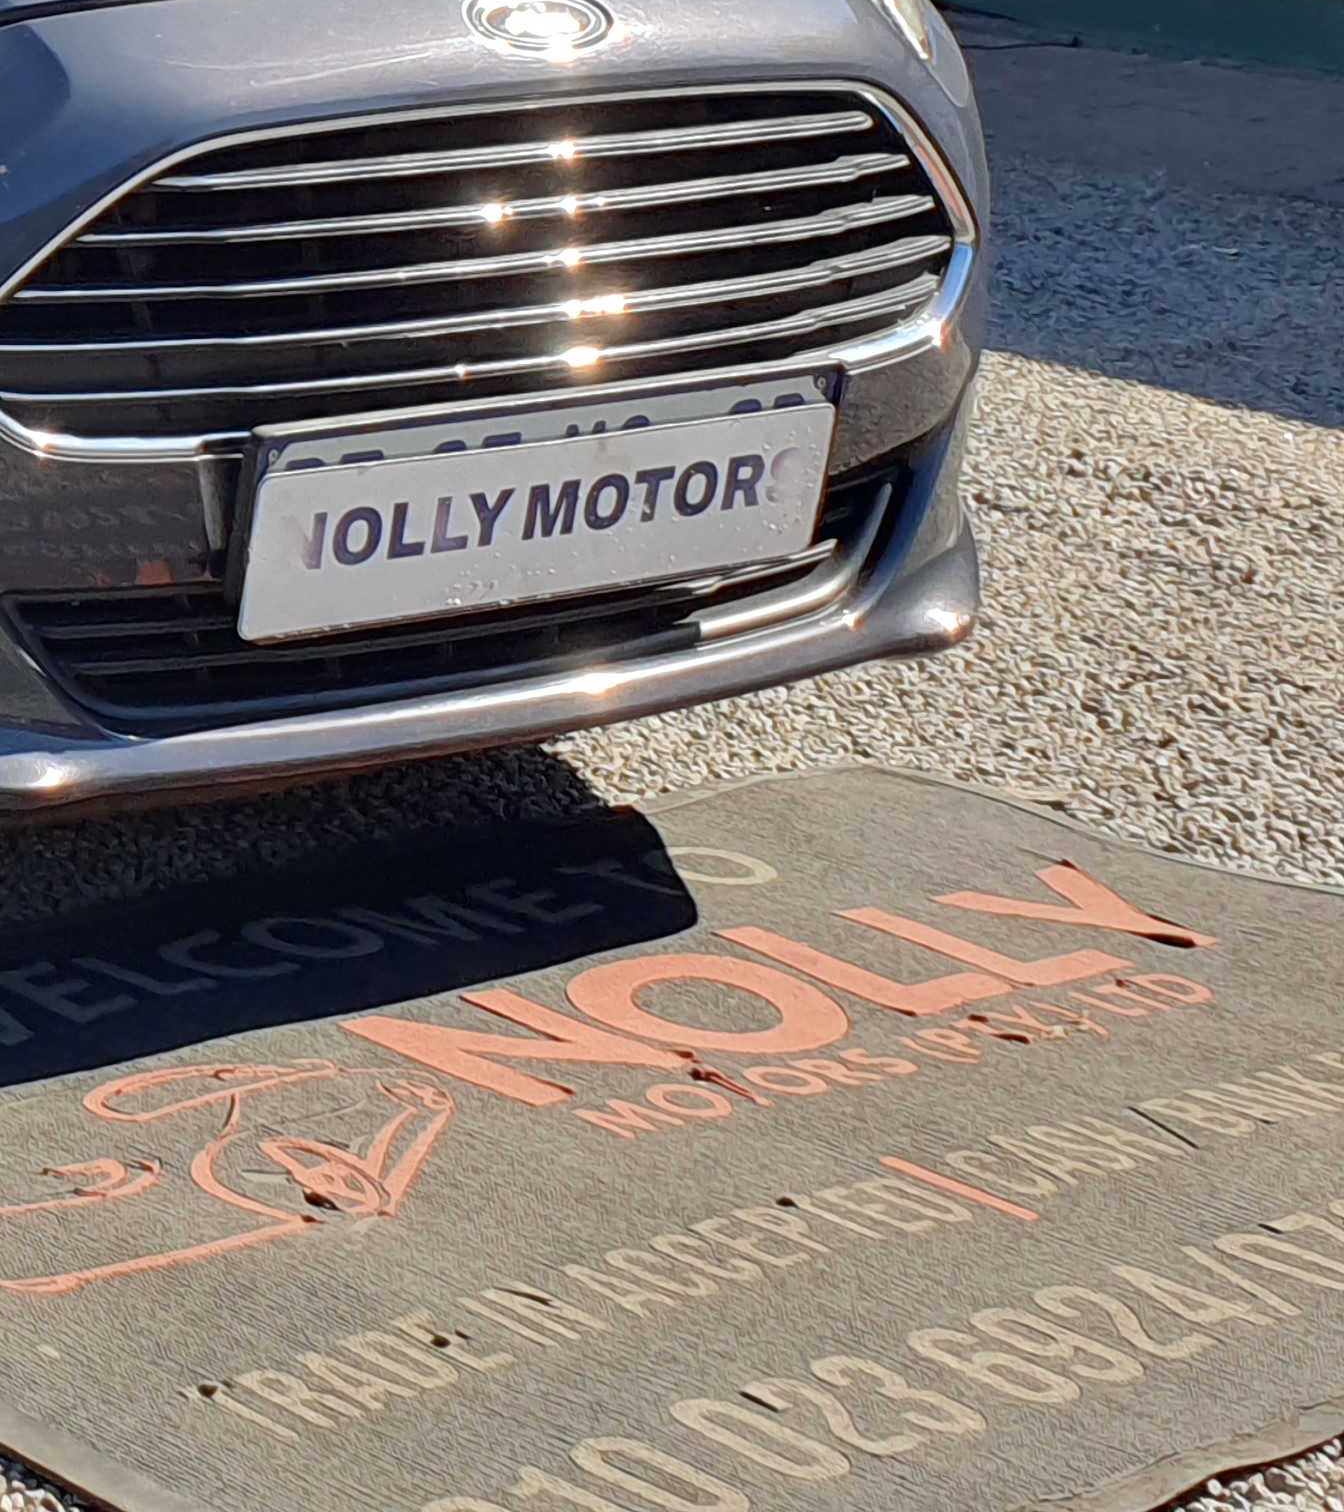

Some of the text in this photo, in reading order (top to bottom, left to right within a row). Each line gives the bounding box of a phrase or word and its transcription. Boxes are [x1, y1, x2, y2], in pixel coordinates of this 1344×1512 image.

[552, 846, 781, 896] TO
[337, 858, 1218, 1106] NOLLY
[669, 1353, 987, 1482] 023
